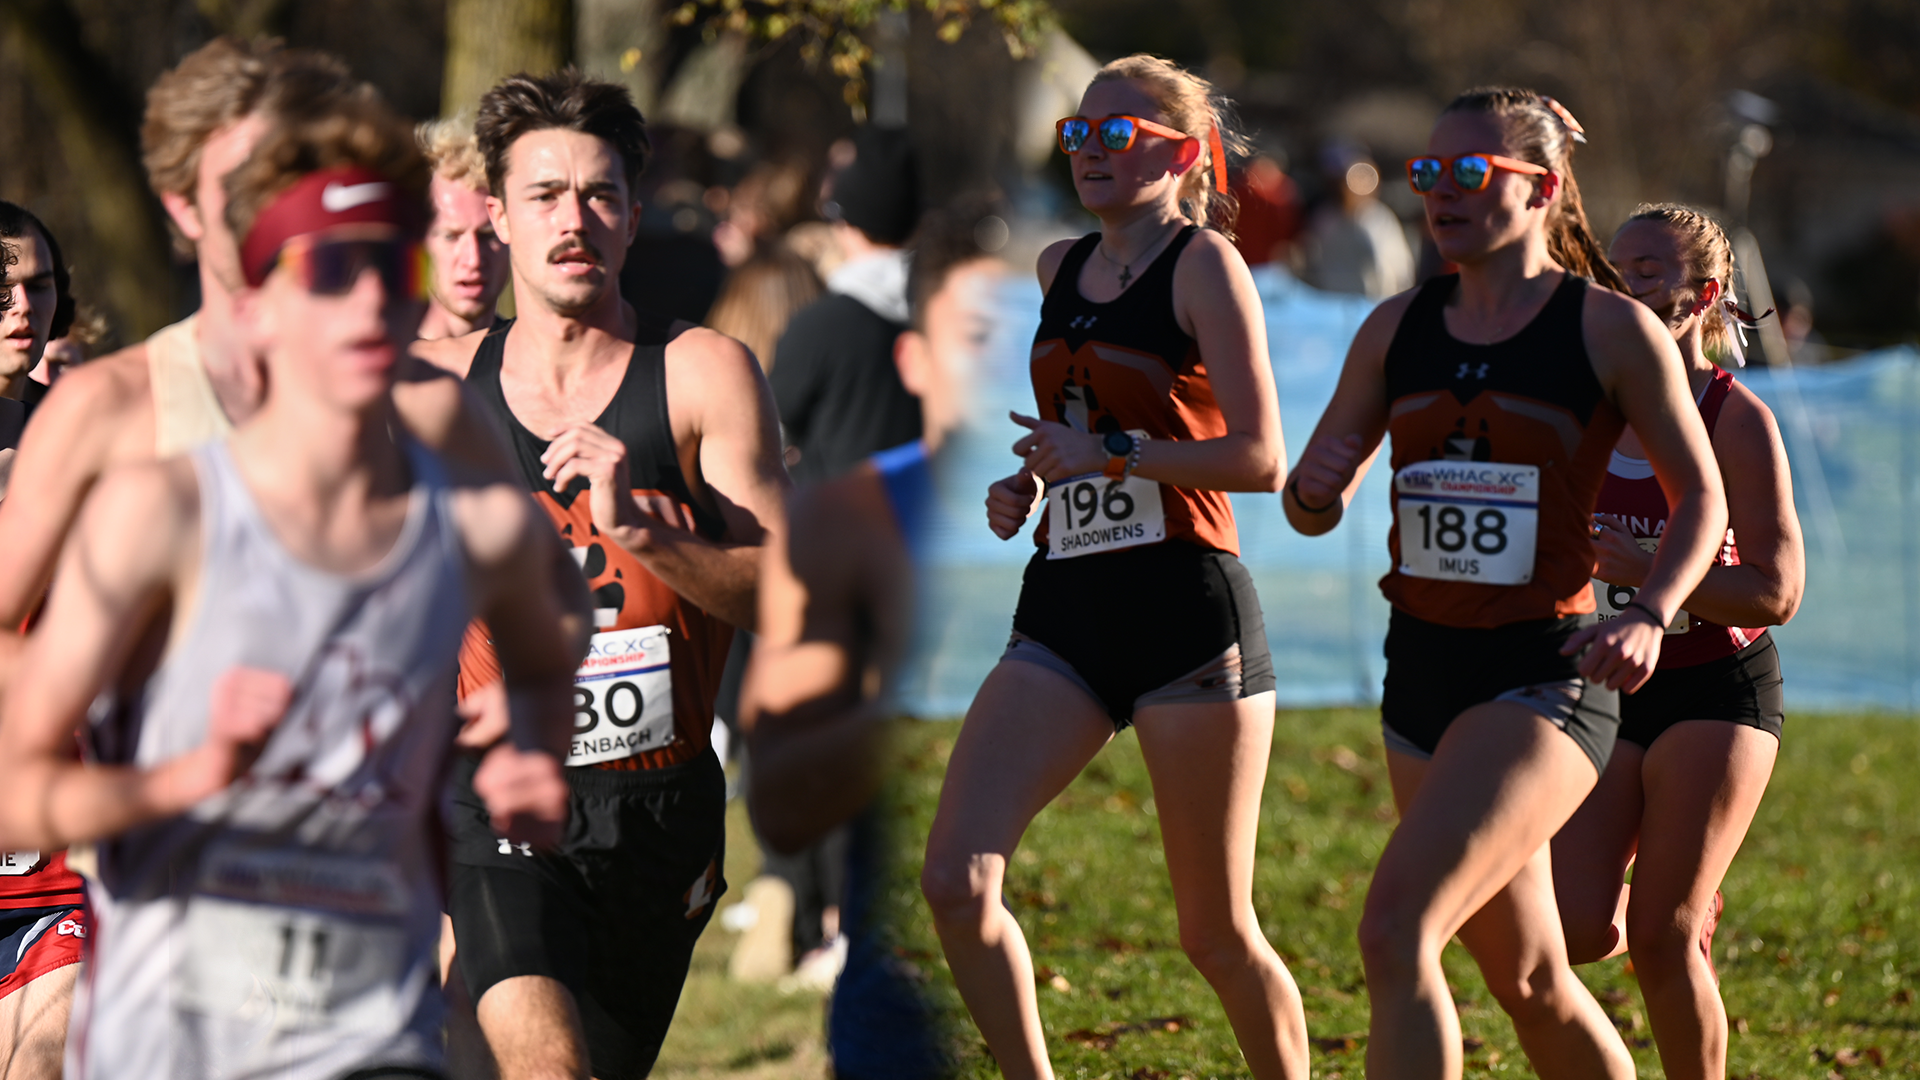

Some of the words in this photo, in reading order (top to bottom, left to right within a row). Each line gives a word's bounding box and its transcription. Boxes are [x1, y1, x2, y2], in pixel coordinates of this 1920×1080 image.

[1433, 467, 1492, 484] WHAC
[1498, 471, 1526, 487] XC
[1440, 481, 1518, 495] CHAMPIONSHIP
[1061, 481, 1135, 530] 196
[1061, 523, 1144, 551] SHADOWENS
[1417, 504, 1508, 556] 188
[1439, 557, 1480, 575] IMUS
[624, 637, 655, 653] XC
[570, 728, 652, 757] ENBACH
